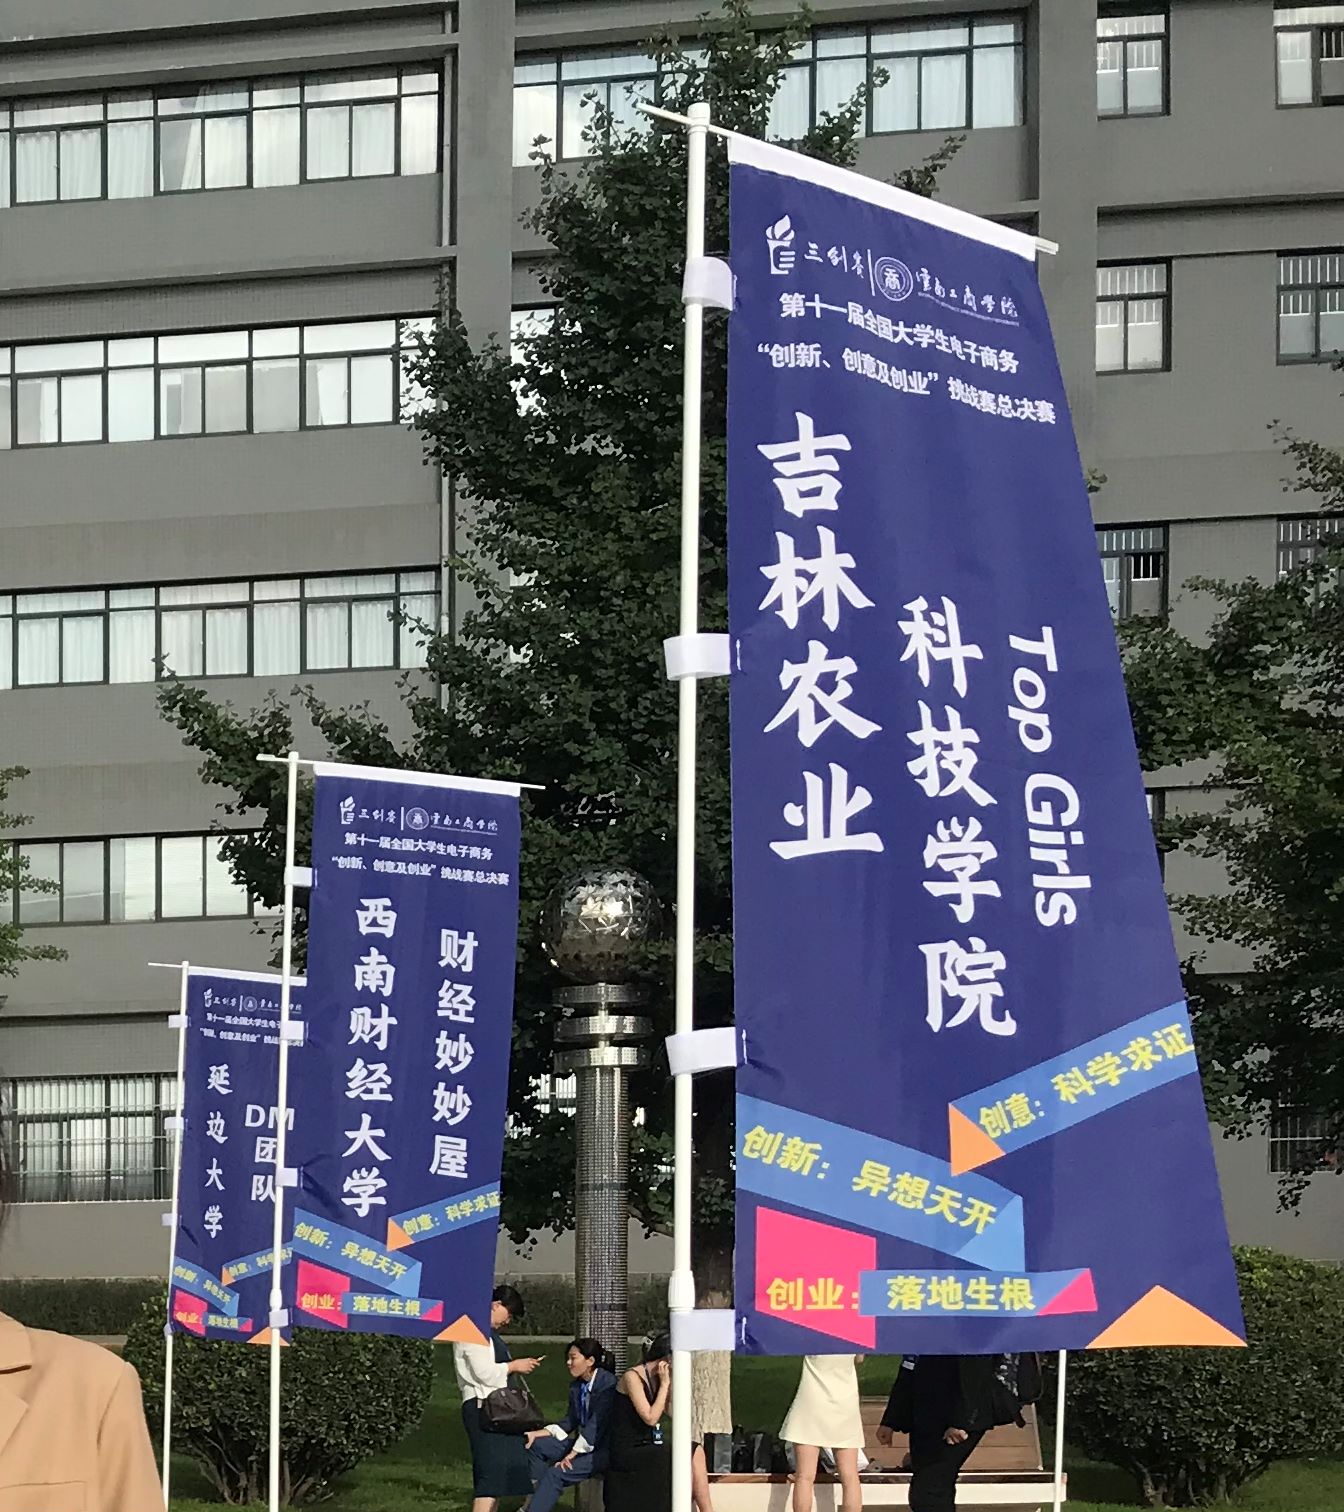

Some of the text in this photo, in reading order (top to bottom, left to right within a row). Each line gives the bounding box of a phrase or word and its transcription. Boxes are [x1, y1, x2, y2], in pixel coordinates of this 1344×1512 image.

[779, 292, 1020, 374] 第十一届全国大学生电子商务
[757, 411, 885, 861] 吉林农业
[1007, 624, 1092, 928] Top Girls
[897, 595, 1016, 1036] 科技学院
[204, 1064, 233, 1238] 延边大学
[340, 897, 398, 1218] 西南财经大学
[429, 928, 478, 1179] 财经妙妙屋
